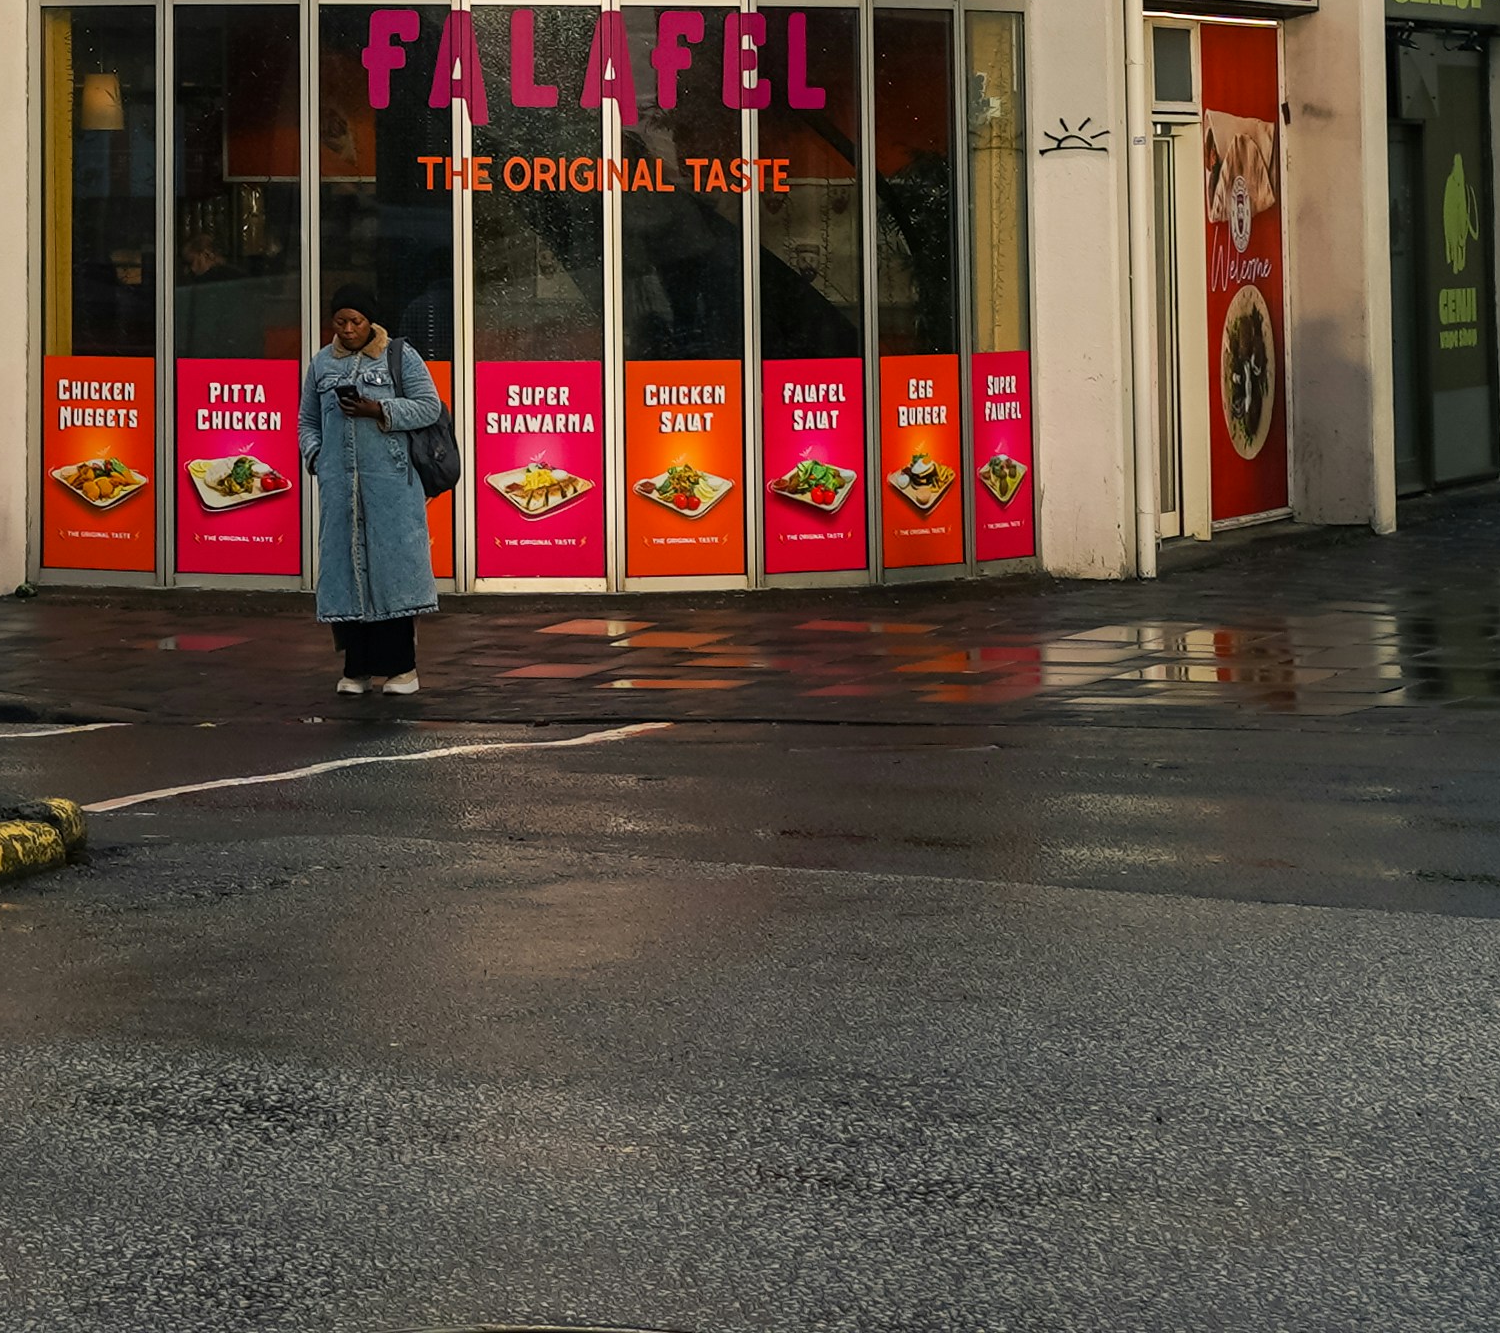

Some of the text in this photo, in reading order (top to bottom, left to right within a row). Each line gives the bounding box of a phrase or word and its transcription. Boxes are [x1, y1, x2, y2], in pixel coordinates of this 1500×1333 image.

[360, 8, 827, 126] FALAFEL
[417, 155, 791, 193] THE ORIGINAL TASTE
[1438, 287, 1478, 325] GENJI
[58, 378, 135, 401] CHICKEN
[209, 382, 266, 403] PITTA
[507, 385, 570, 406] SUPER
[645, 384, 726, 405] CHICKEN
[783, 382, 846, 404] FALAFEL
[908, 378, 933, 399] EGG
[987, 375, 1017, 396] SUPER
[59, 406, 138, 430] NUGGETS
[197, 409, 281, 431] CHICKEN
[660, 411, 714, 433] SALAT
[792, 409, 840, 431] SALAT
[898, 405, 947, 427] BURGER
[985, 401, 1022, 422] FALAFEL
[486, 412, 595, 434] SHAWARMA
